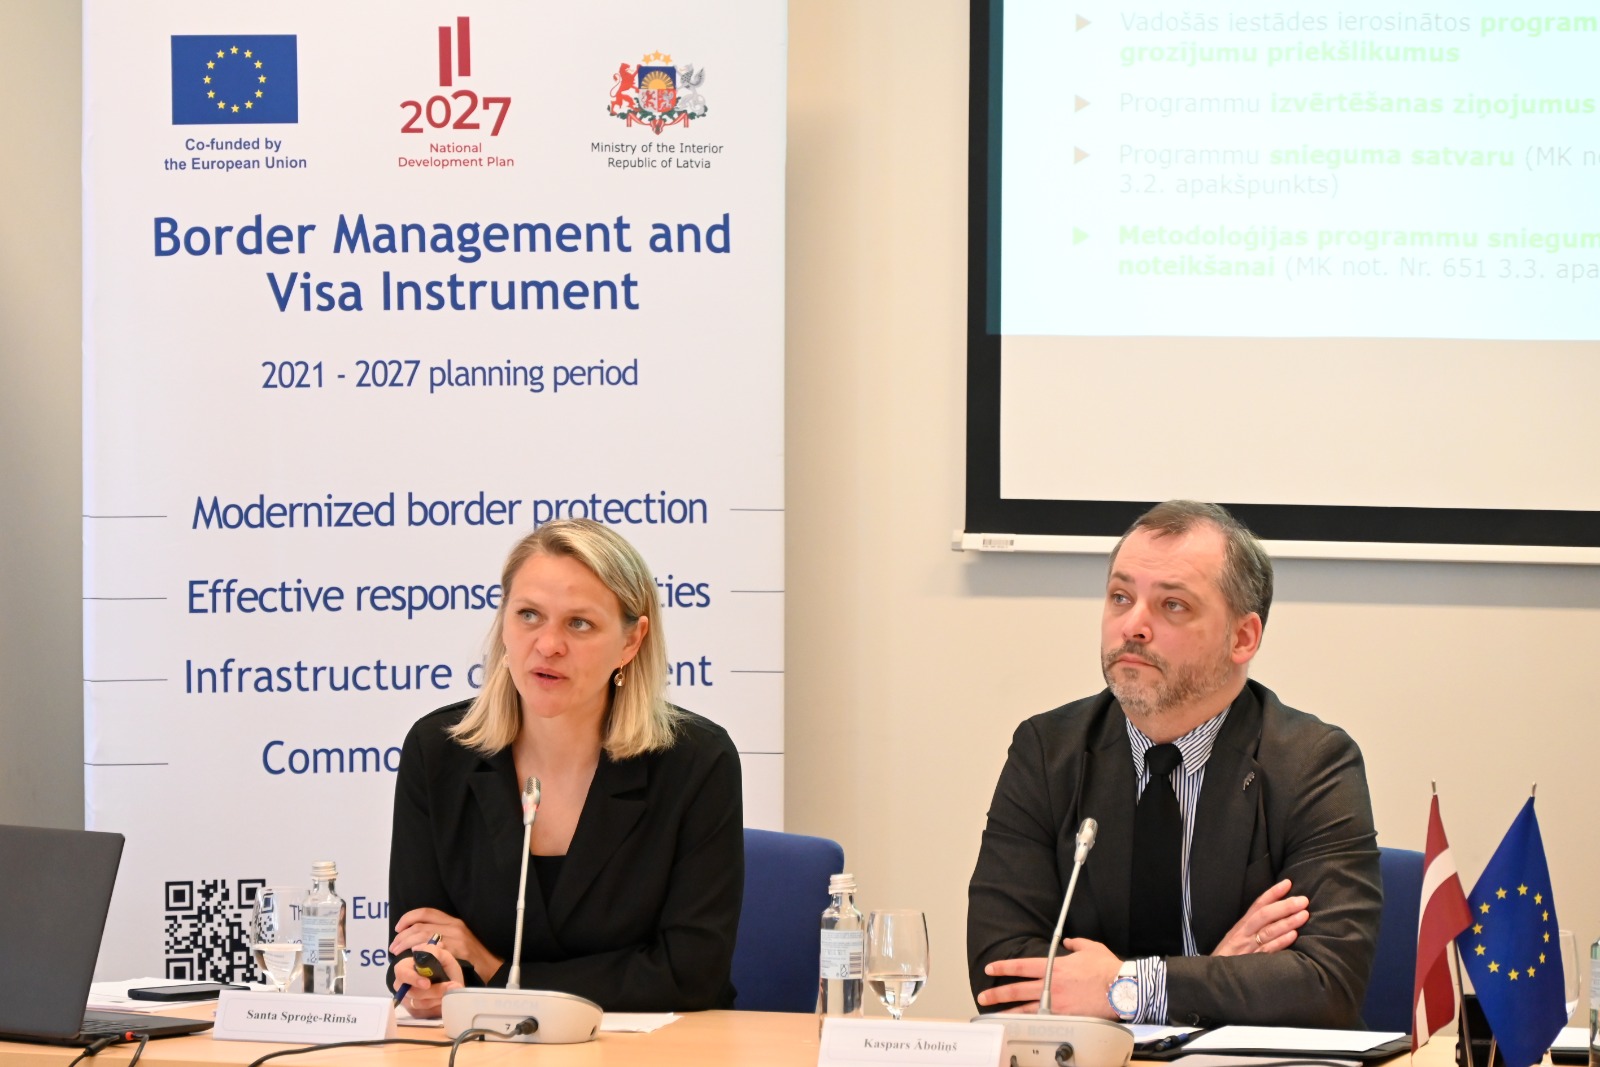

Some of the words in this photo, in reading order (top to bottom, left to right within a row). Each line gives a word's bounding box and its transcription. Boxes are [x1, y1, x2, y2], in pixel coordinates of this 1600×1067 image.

[1120, 11, 1218, 31] Vadošās
[1229, 11, 1327, 32] iestādes
[1339, 12, 1470, 32] ierosinātos
[1480, 16, 1598, 37] program
[1120, 42, 1257, 67] grozījumu
[1268, 41, 1460, 66] priekšlikumus
[399, 89, 512, 137] 2027
[1120, 93, 1260, 117] Programmu
[1272, 92, 1443, 113] izvērtēšanas
[1453, 94, 1596, 119] ziņojumus
[185, 137, 260, 151] Co-funded
[264, 137, 282, 153] by
[429, 142, 482, 153] National
[591, 141, 637, 156] Ministry
[641, 141, 653, 153] of
[656, 142, 676, 154] the
[679, 142, 724, 154] Interior
[1120, 144, 1260, 169] Programmu
[1270, 144, 1401, 169] snieguma
[1411, 147, 1514, 166] satvaru
[1525, 146, 1572, 171] (MK
[163, 157, 187, 171] the
[191, 157, 260, 173] European
[265, 156, 307, 169] Union
[398, 156, 484, 170] Development
[487, 156, 515, 167] Plan
[607, 156, 657, 170] Republic
[660, 157, 673, 169] of
[676, 157, 711, 169] Latvia
[1120, 174, 1164, 193] 3.2.
[1176, 173, 1338, 199] apakšpunkts)
[153, 213, 317, 257] Border
[333, 213, 632, 264] Management
[649, 212, 731, 254] and
[1119, 224, 1308, 251] Metodoloģijas
[1318, 230, 1478, 251] programmu
[1488, 229, 1600, 254] sniegum
[1119, 256, 1274, 276] noteikšanai
[1286, 257, 1332, 281] (MK
[1343, 258, 1388, 276] not.
[1400, 257, 1430, 276] Nr.
[1443, 258, 1486, 278] 651
[1498, 259, 1544, 278] 3.3.
[266, 271, 364, 313] Visa
[382, 270, 640, 311] Instrument
[261, 360, 323, 389] 2021
[355, 359, 421, 388] 2027
[429, 358, 545, 394] planning
[553, 358, 638, 394] period
[191, 491, 395, 530] Modernized
[407, 490, 523, 527] border
[533, 491, 708, 531] protection
[188, 578, 345, 614] Effective
[356, 579, 502, 618] response
[185, 657, 453, 694] Infrastructure
[262, 740, 401, 773] Commo
[246, 1009, 278, 1021] Santa
[1027, 1025, 1074, 1037] BOSCH
[864, 1038, 911, 1052] Kaspars
